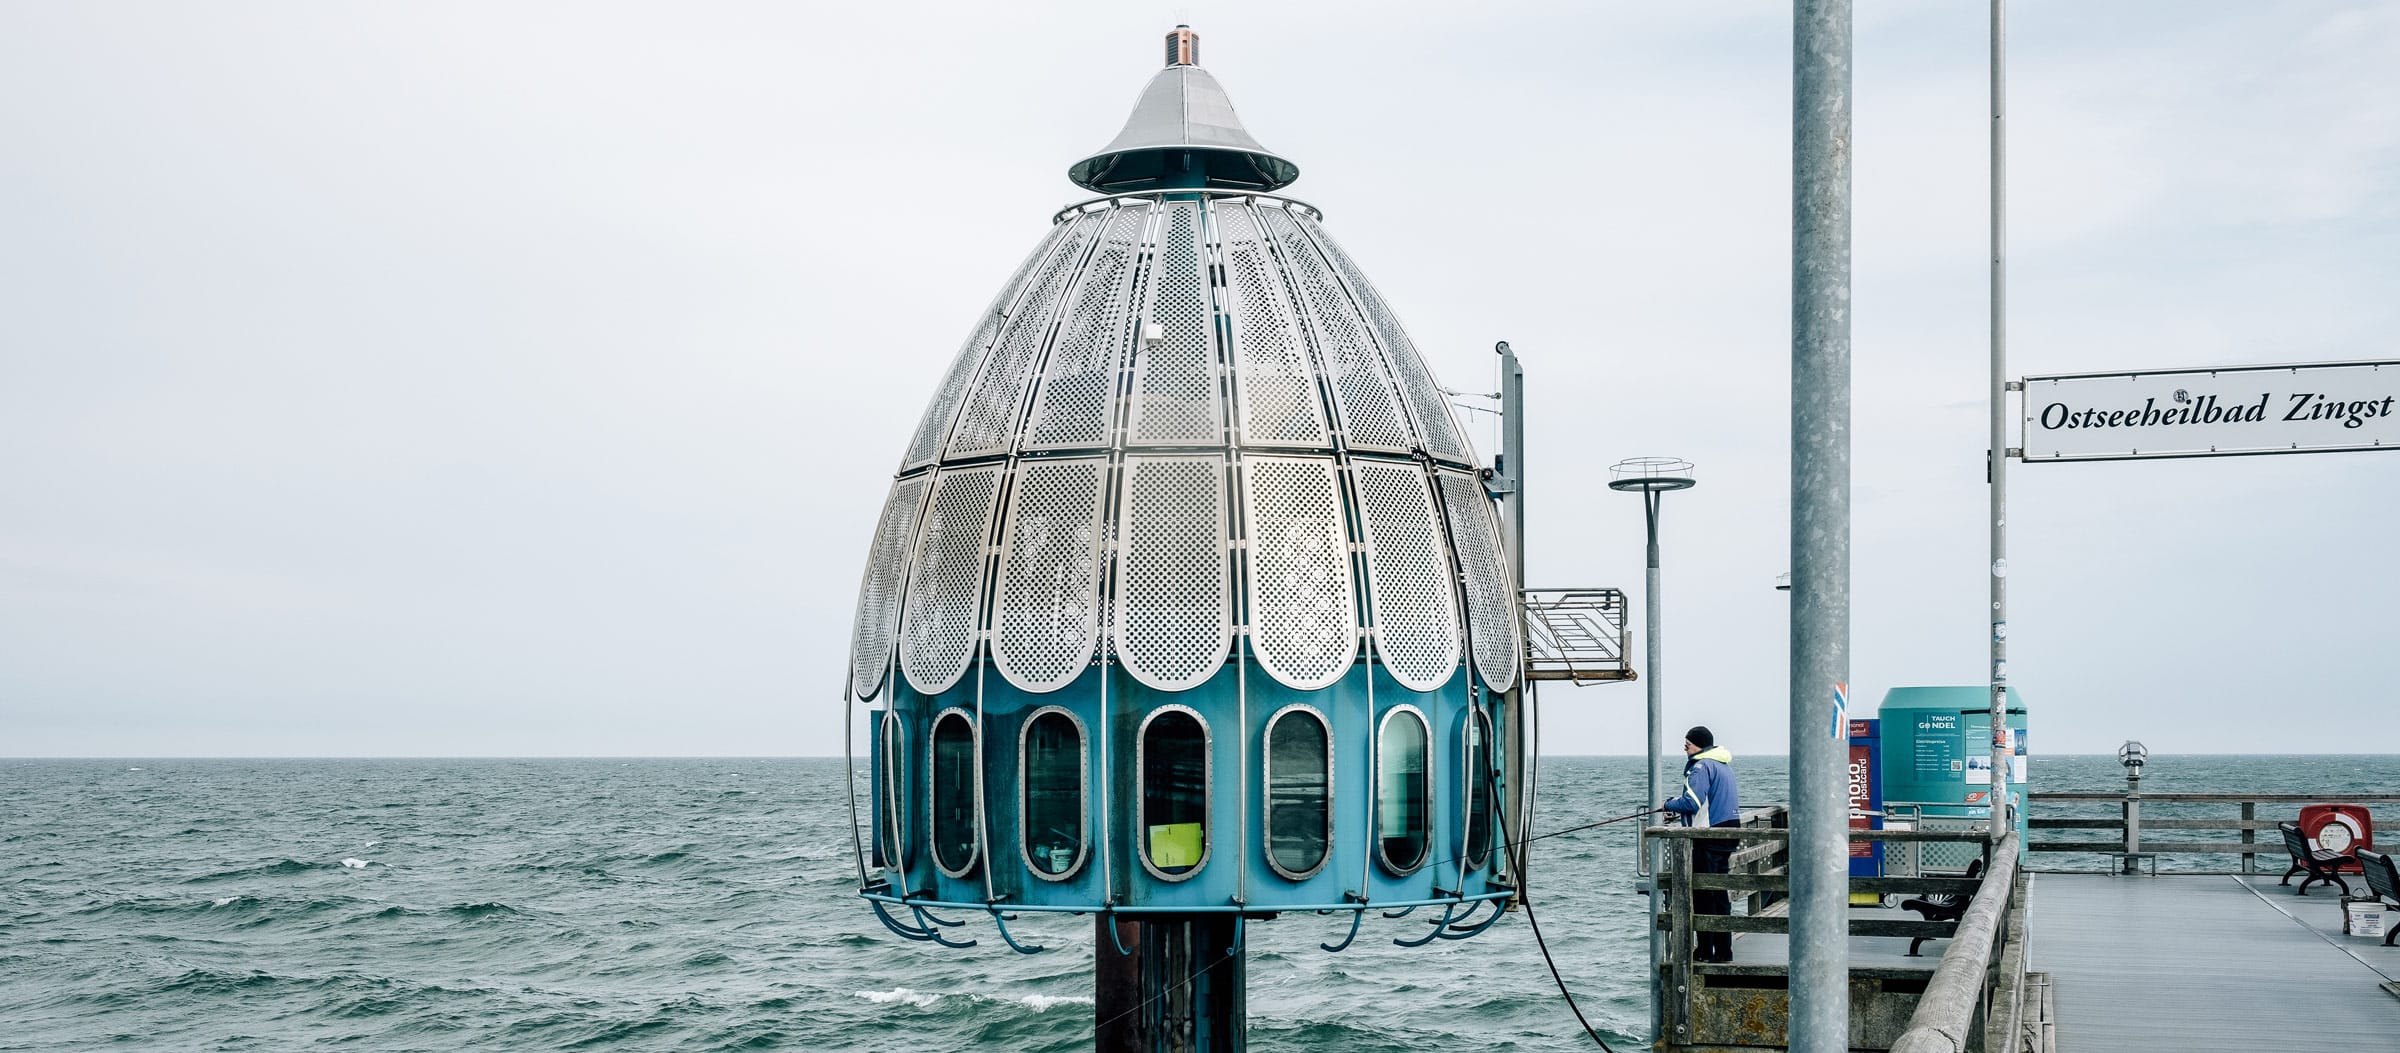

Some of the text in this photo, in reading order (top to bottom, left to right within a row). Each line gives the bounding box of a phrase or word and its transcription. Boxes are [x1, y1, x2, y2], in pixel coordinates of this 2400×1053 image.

[2040, 393, 2271, 430] Ostseeheilbad
[2282, 393, 2396, 429] Zingst
[1848, 763, 1867, 820] photo
[1858, 758, 1870, 800] postcard
